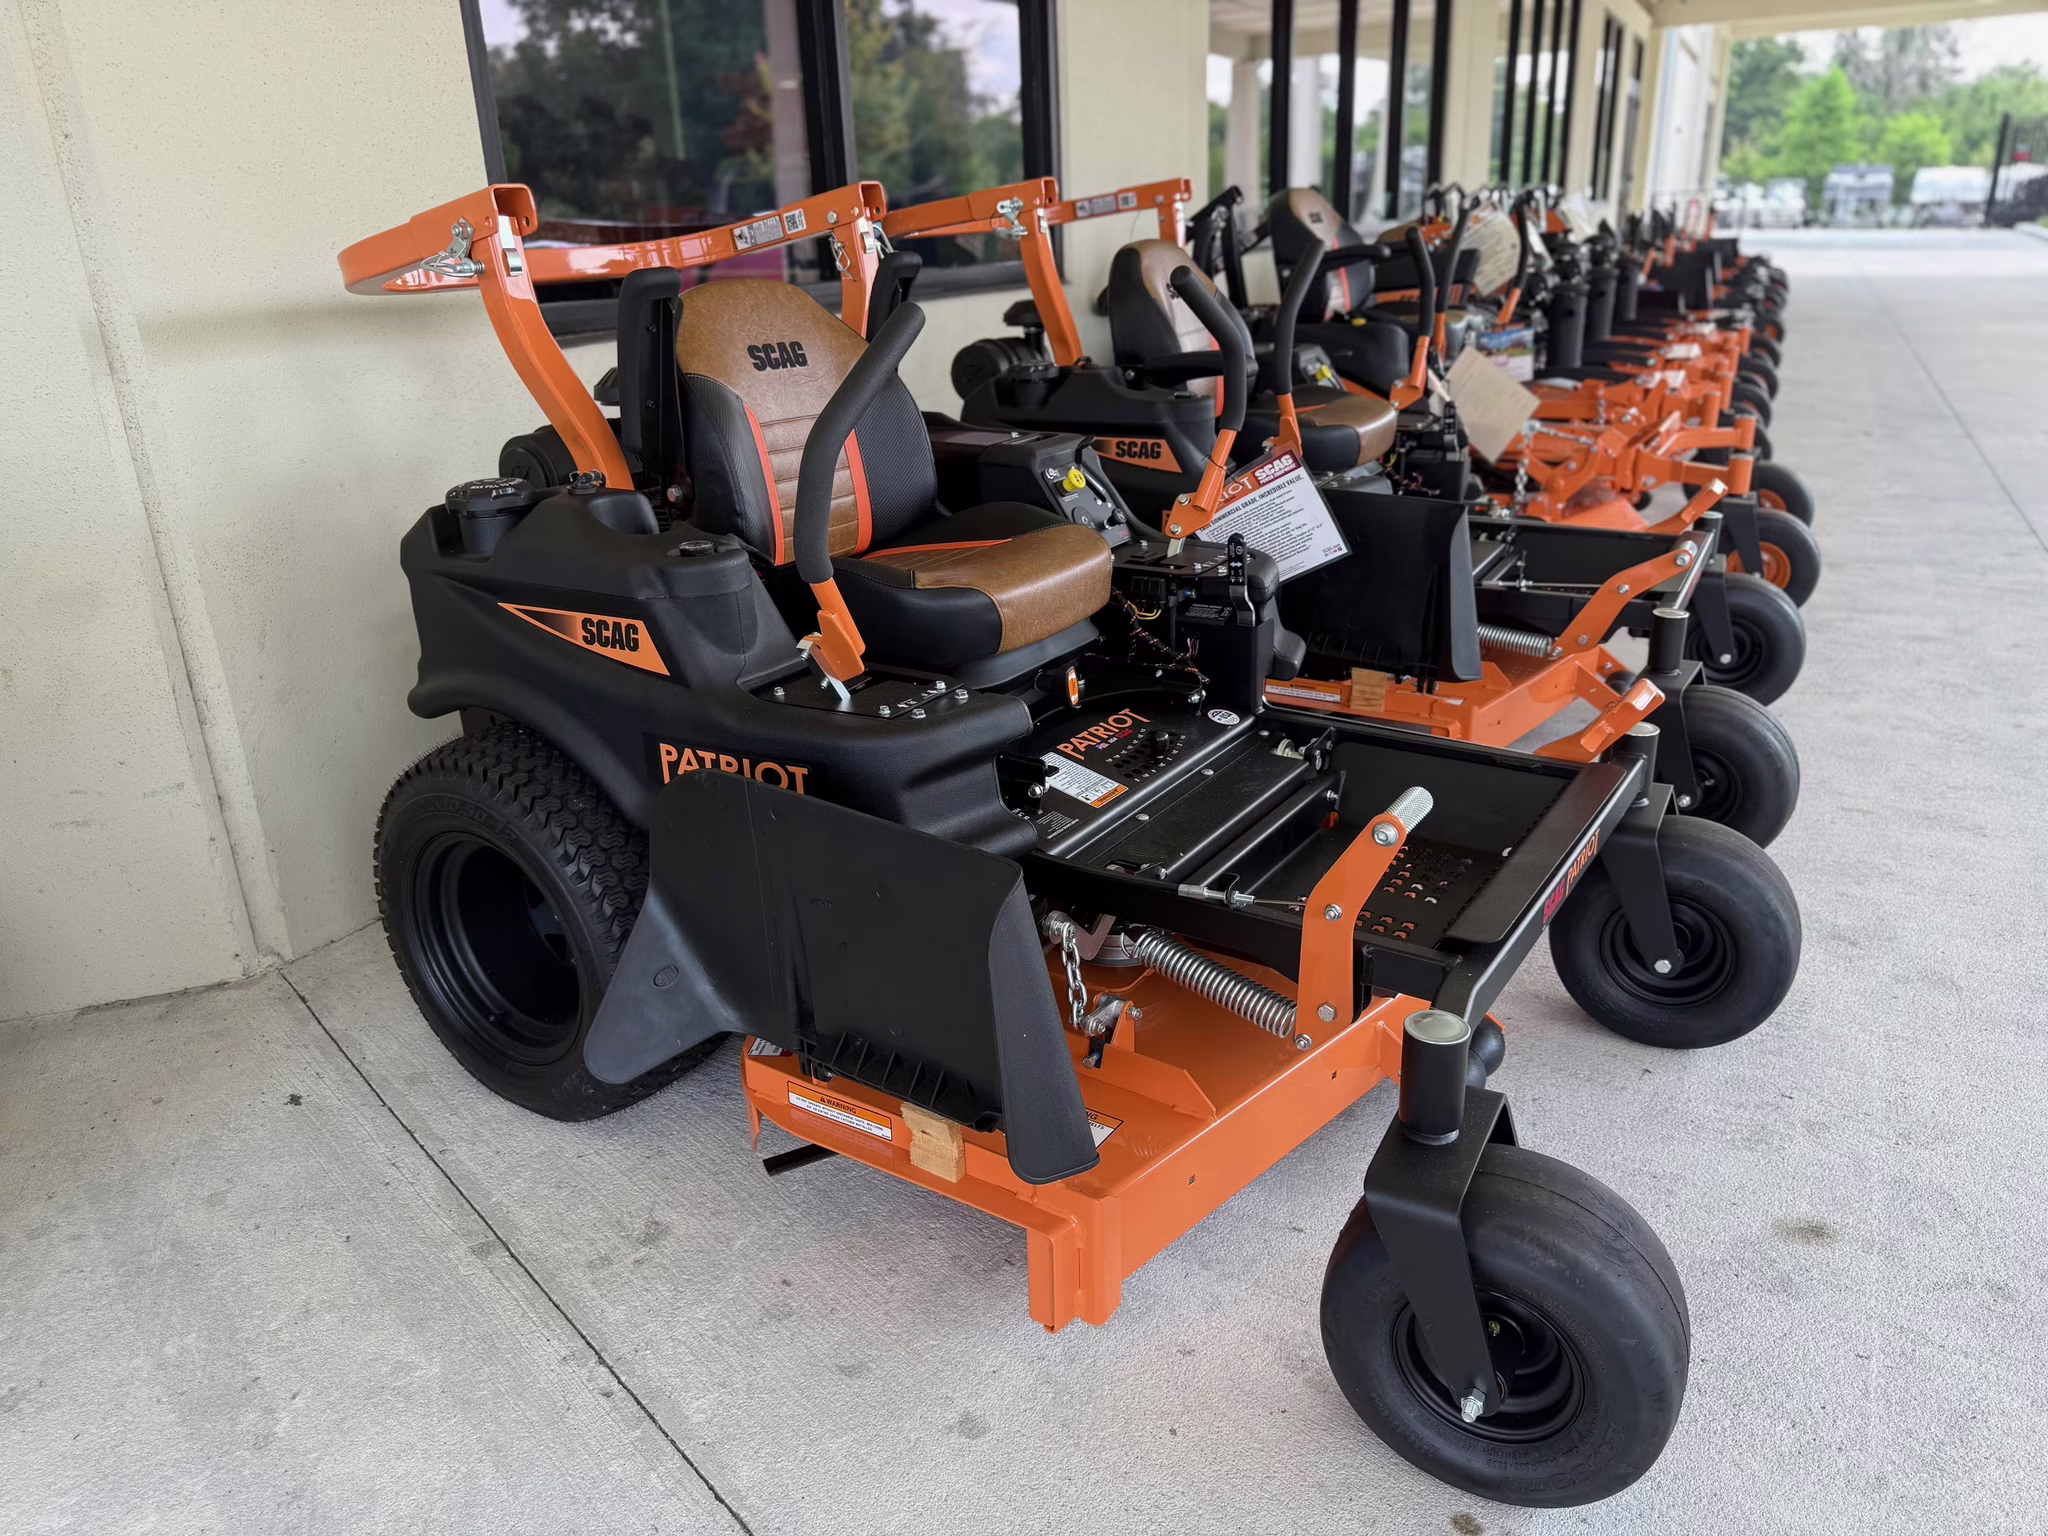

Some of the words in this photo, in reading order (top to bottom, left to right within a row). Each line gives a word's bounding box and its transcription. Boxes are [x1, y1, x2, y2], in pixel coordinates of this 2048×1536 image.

[747, 341, 808, 372] SCAG
[1115, 440, 1162, 460] SCAG
[1254, 454, 1294, 481] SCAG
[1211, 504, 1242, 527] COMMERCIAL
[1259, 483, 1287, 500] INCREDIBLE
[581, 617, 639, 652] SCAG
[1056, 708, 1151, 761] PATRIOT
[659, 743, 809, 795] PATRIOT
[1565, 827, 1600, 897] PATRIOT
[826, 1098, 857, 1114] WARNING
